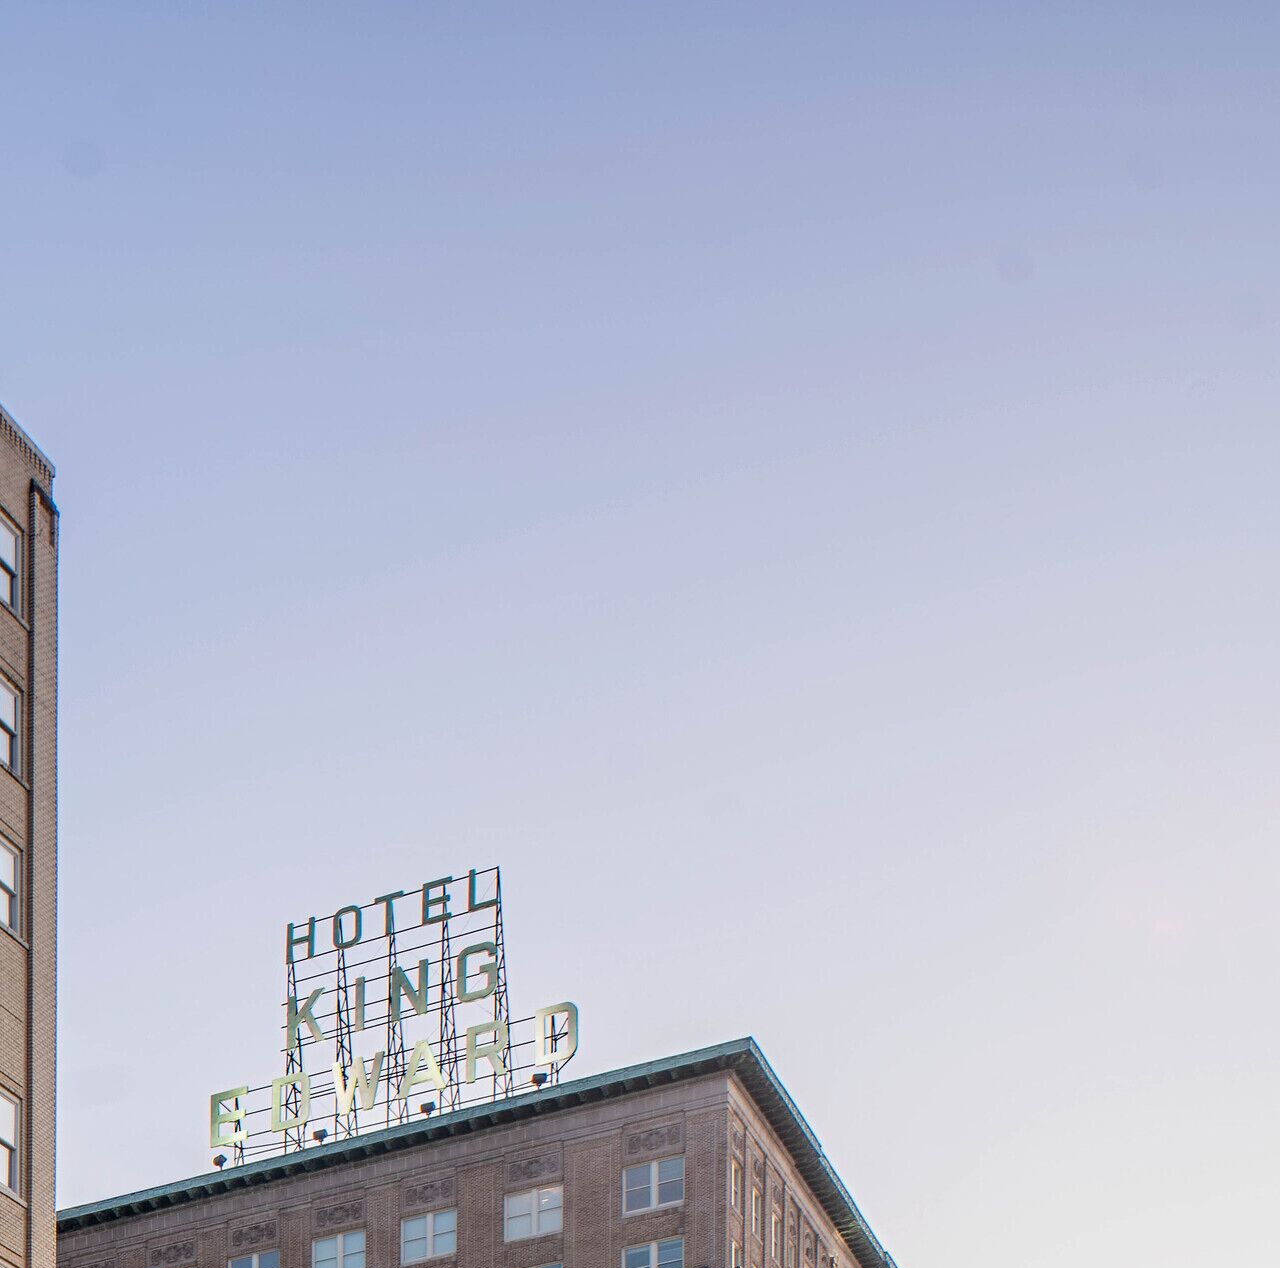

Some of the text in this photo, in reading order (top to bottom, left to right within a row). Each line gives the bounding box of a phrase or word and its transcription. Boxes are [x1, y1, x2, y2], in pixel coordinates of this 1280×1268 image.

[285, 868, 500, 965] HOTEL
[285, 941, 498, 1051] KING
[210, 1002, 579, 1149] EDWARD
